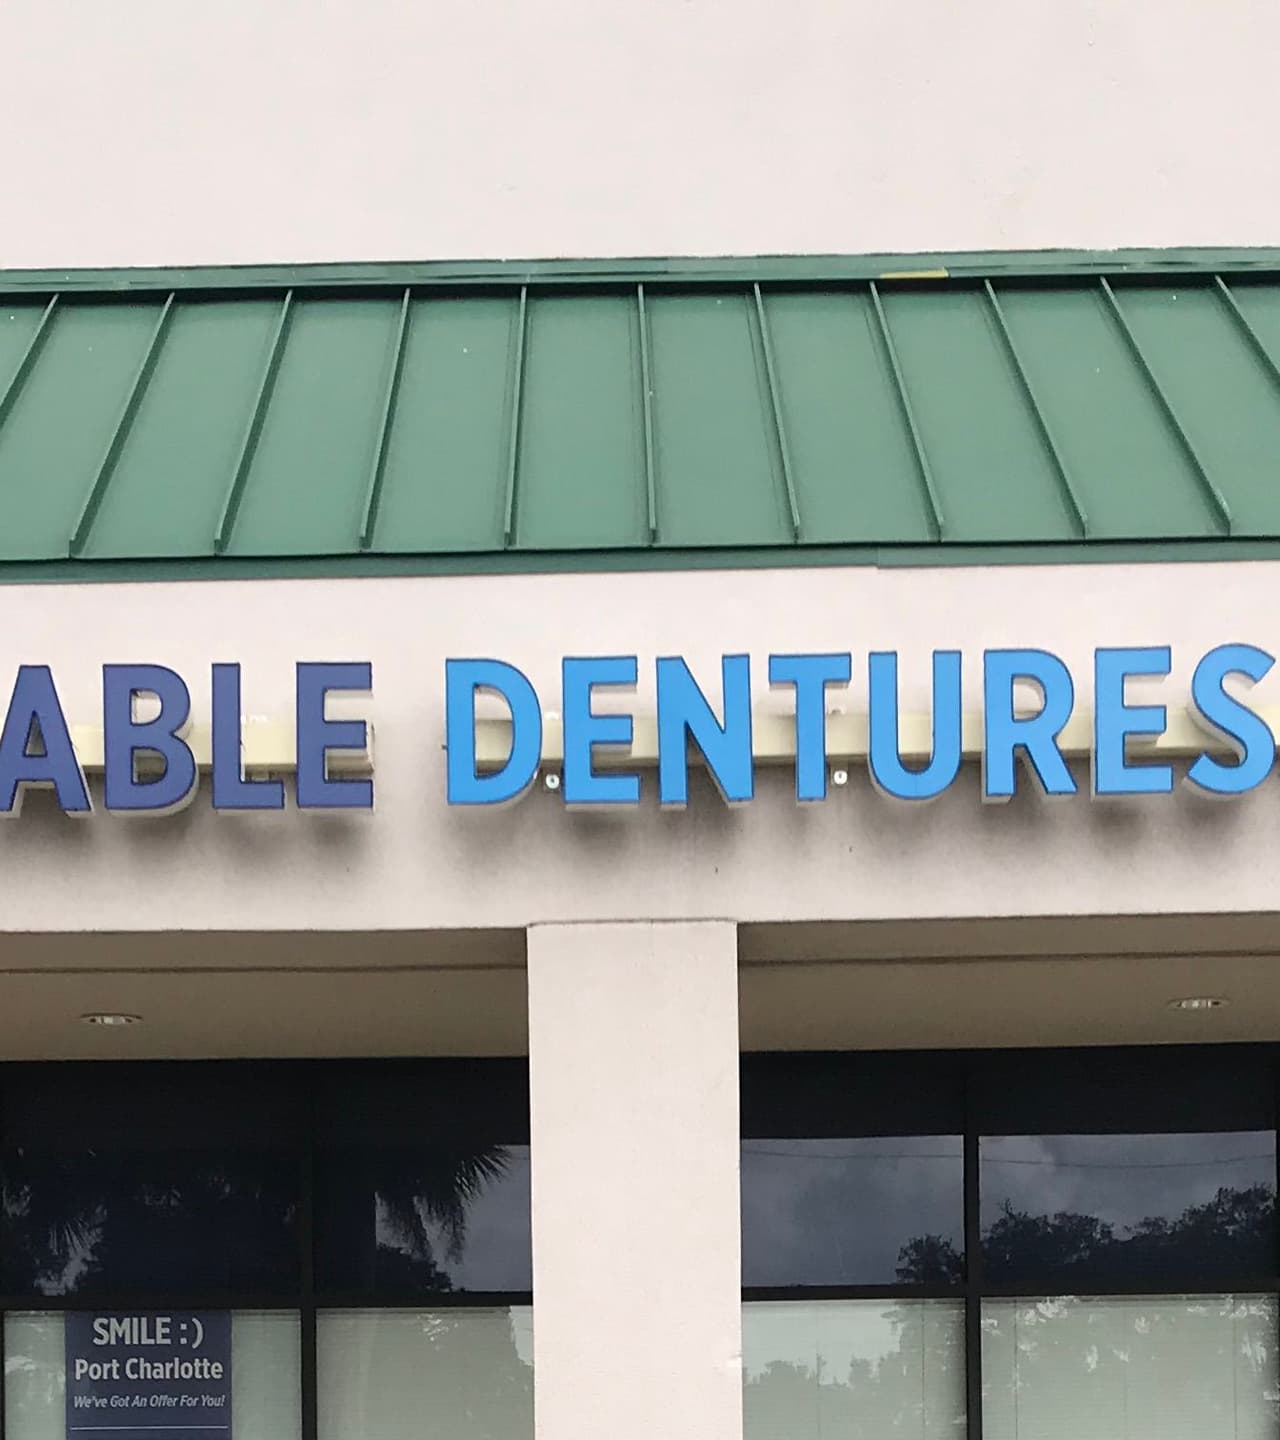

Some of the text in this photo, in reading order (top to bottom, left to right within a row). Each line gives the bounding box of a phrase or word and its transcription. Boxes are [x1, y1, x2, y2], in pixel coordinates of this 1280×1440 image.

[445, 642, 1277, 808] DENTURES
[92, 1317, 172, 1345] SMILE
[75, 1357, 223, 1380] Port Charlotte
[74, 1395, 225, 1408] We've Got An Offer For You!
